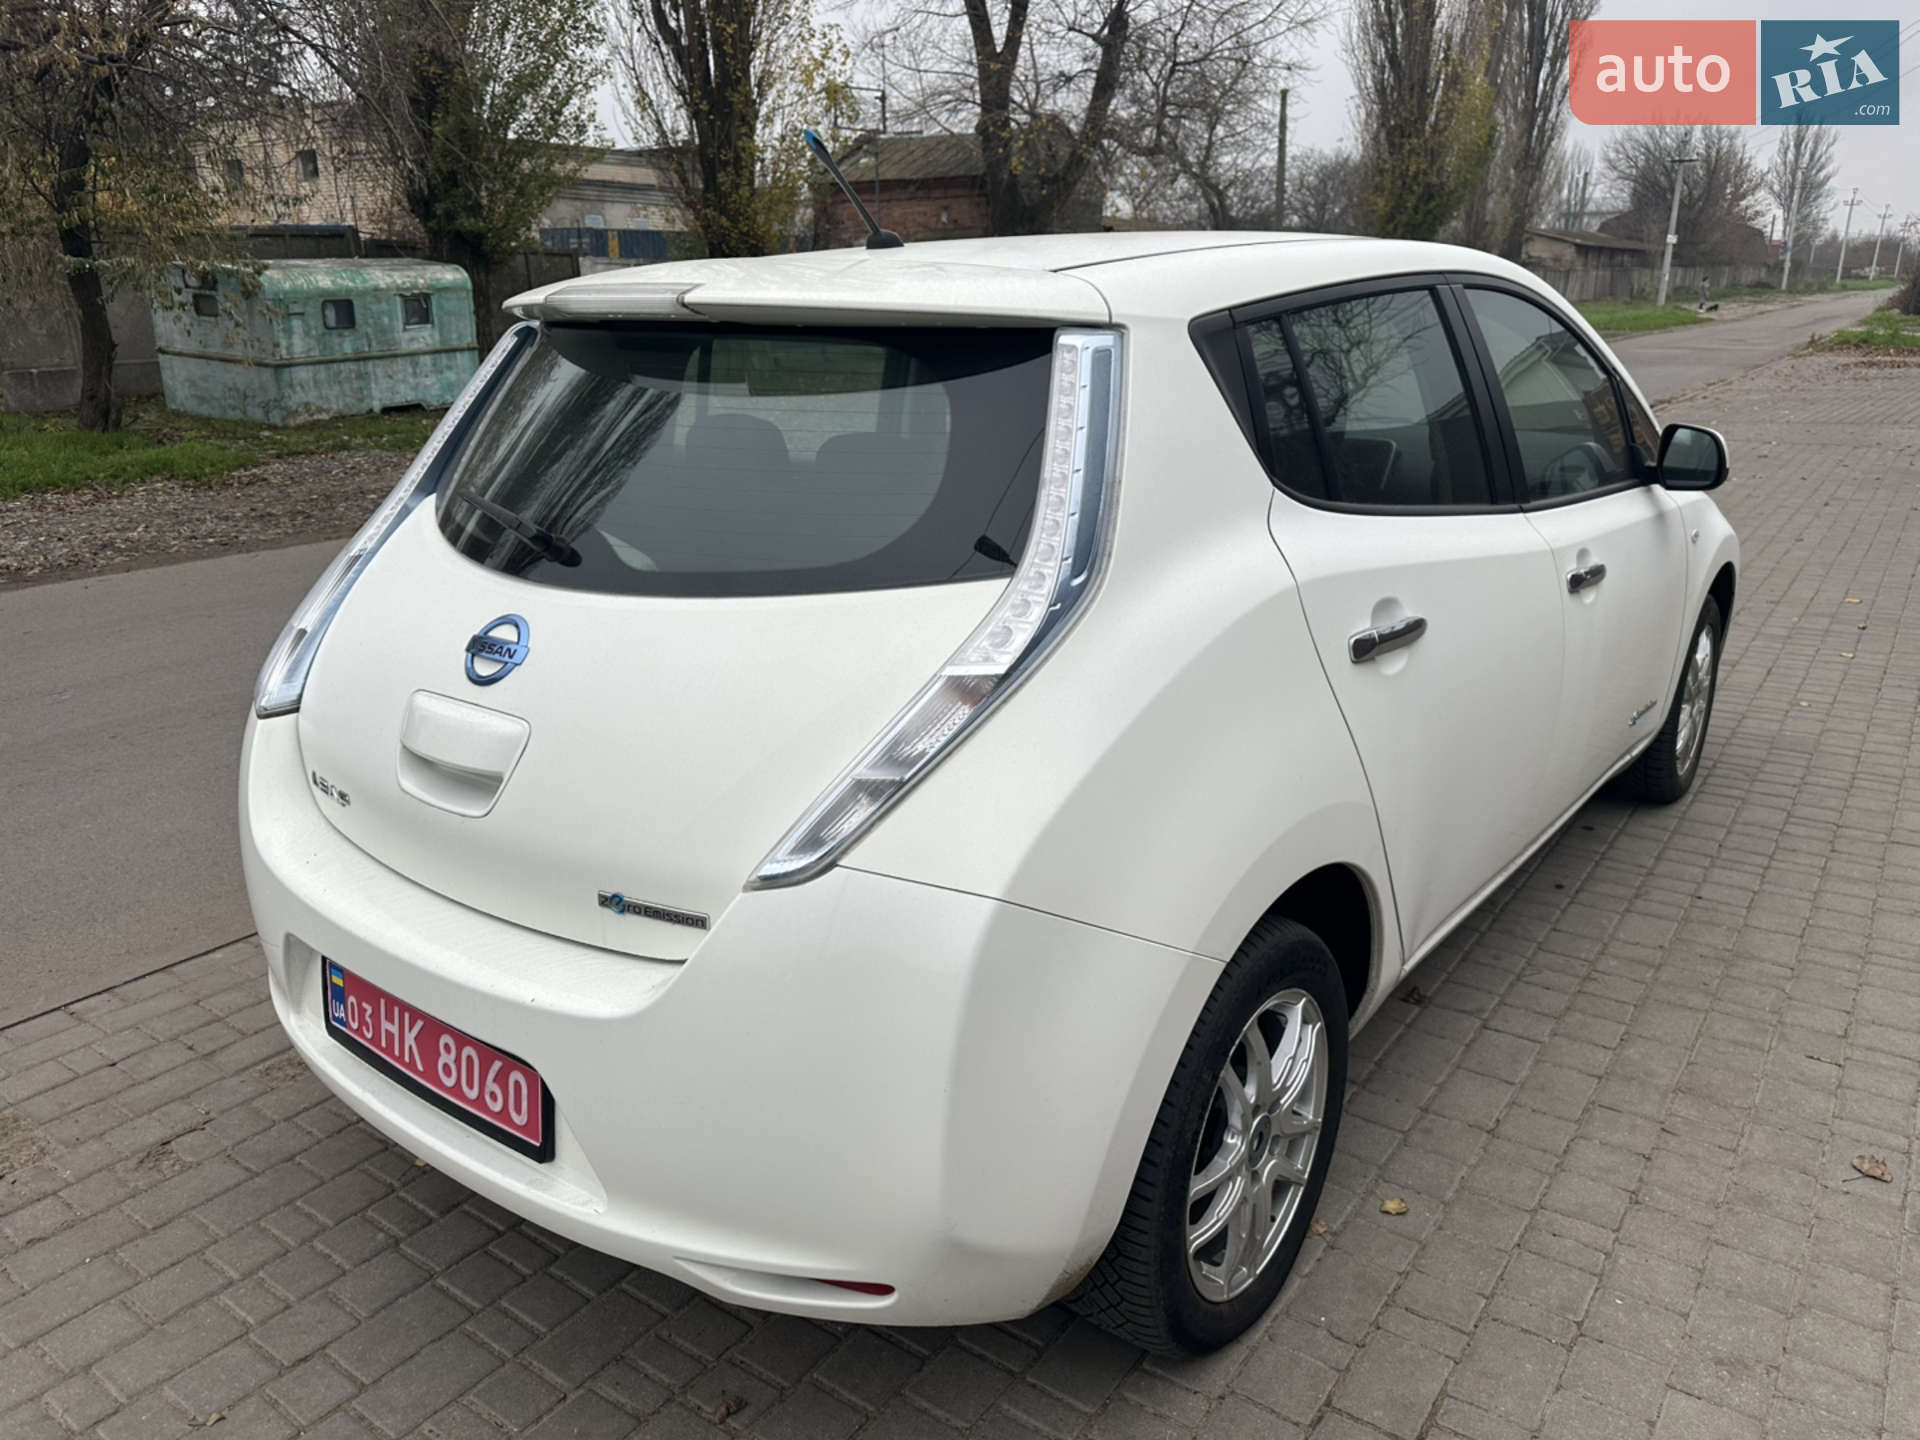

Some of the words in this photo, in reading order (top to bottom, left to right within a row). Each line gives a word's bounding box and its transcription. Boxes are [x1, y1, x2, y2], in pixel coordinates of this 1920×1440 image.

[470, 637, 517, 659] NISSAN
[644, 906, 705, 928] Emission
[333, 999, 346, 1022] UA
[347, 995, 373, 1040] 03
[380, 998, 424, 1072] HK
[437, 1033, 529, 1126] 8060
